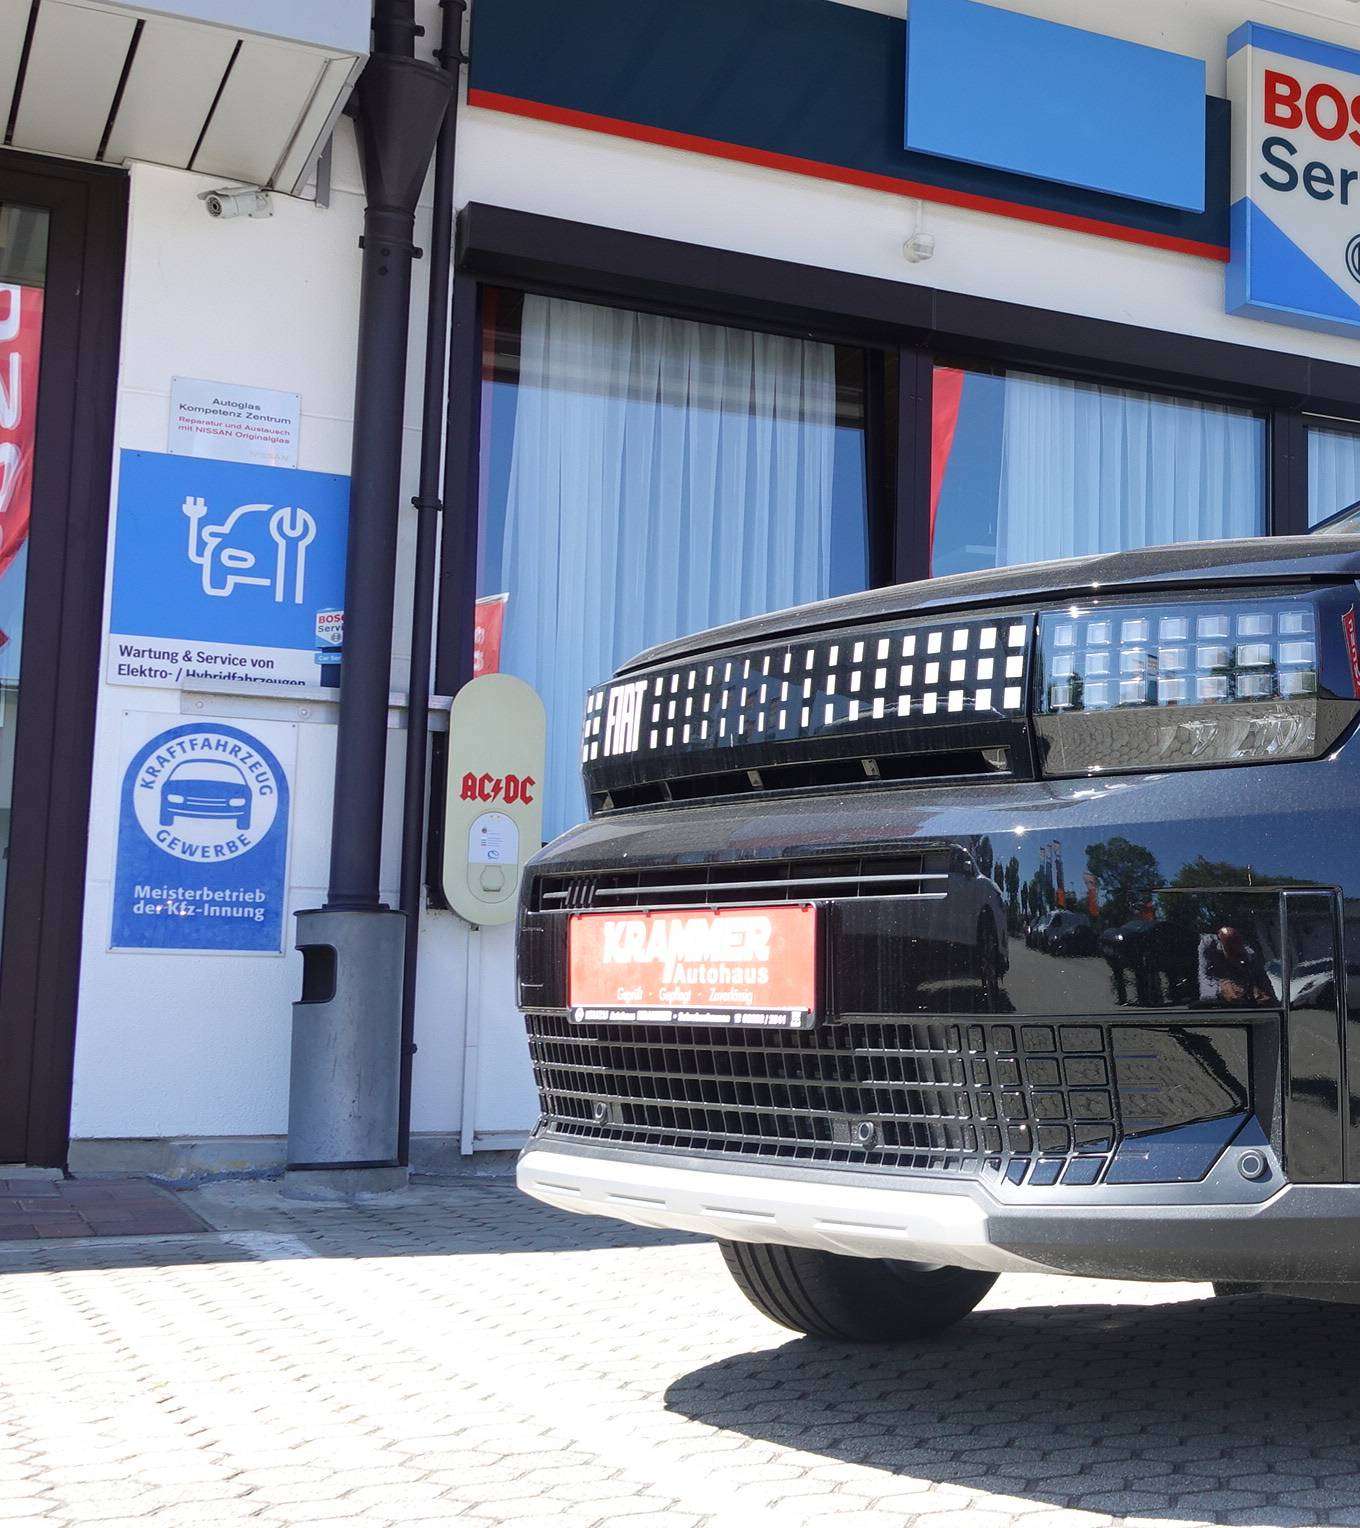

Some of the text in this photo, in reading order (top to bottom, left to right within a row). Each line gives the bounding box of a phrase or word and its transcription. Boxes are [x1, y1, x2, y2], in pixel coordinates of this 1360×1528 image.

[179, 403, 291, 425] Kompetenz Zentrum
[212, 398, 261, 411] Autoglas
[178, 416, 290, 436] Reparatur und Austausch
[195, 427, 232, 437] NISSAN
[235, 431, 290, 444] Originalglas
[318, 614, 344, 624] BOS
[119, 645, 275, 669] Wartung & Service von
[117, 663, 173, 679] Elektro-
[603, 680, 648, 757] FIAT
[140, 737, 274, 796] KRAFTFAHRZEUG
[156, 829, 252, 859] GEWERBE
[133, 885, 266, 903] Meisterbetrieb
[132, 900, 265, 922] der Kfz-Innung
[672, 963, 769, 984] Autohaus
